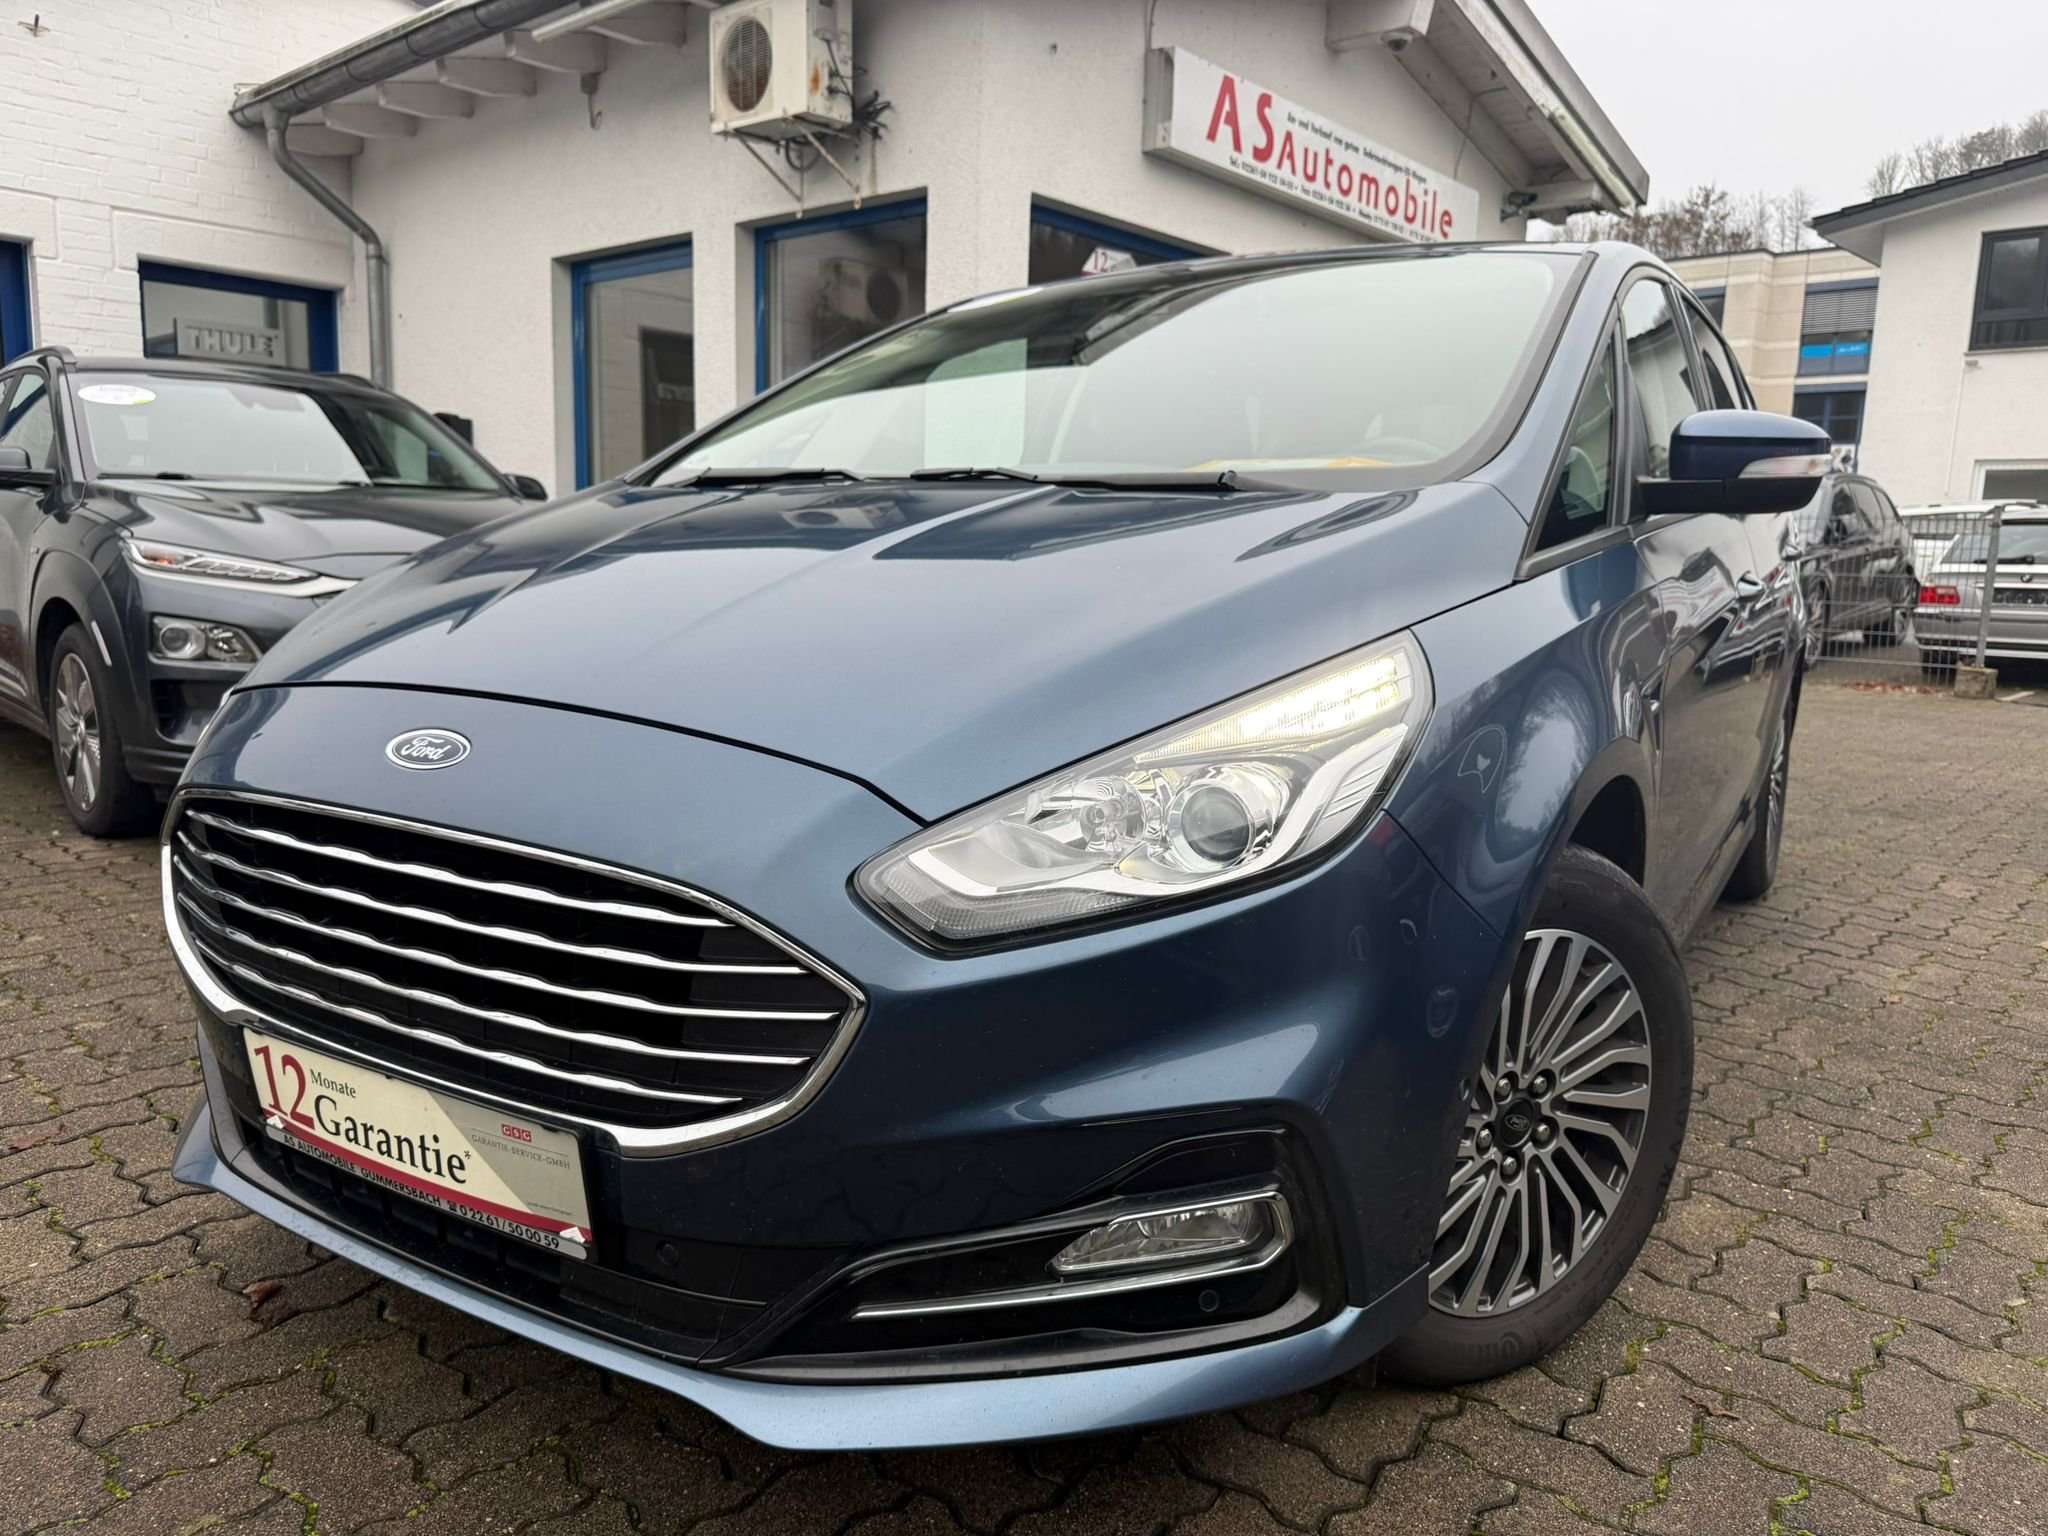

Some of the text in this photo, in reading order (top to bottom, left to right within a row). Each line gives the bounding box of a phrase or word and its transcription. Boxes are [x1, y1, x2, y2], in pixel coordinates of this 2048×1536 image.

[185, 325, 273, 358] THULE
[400, 736, 452, 760] Ford
[254, 1045, 316, 1131] 12
[310, 1068, 357, 1099] Monate
[283, 1134, 295, 1146] AS
[298, 1141, 355, 1172] AUTOMOBILE
[360, 1167, 442, 1207] GUMMERSBACH
